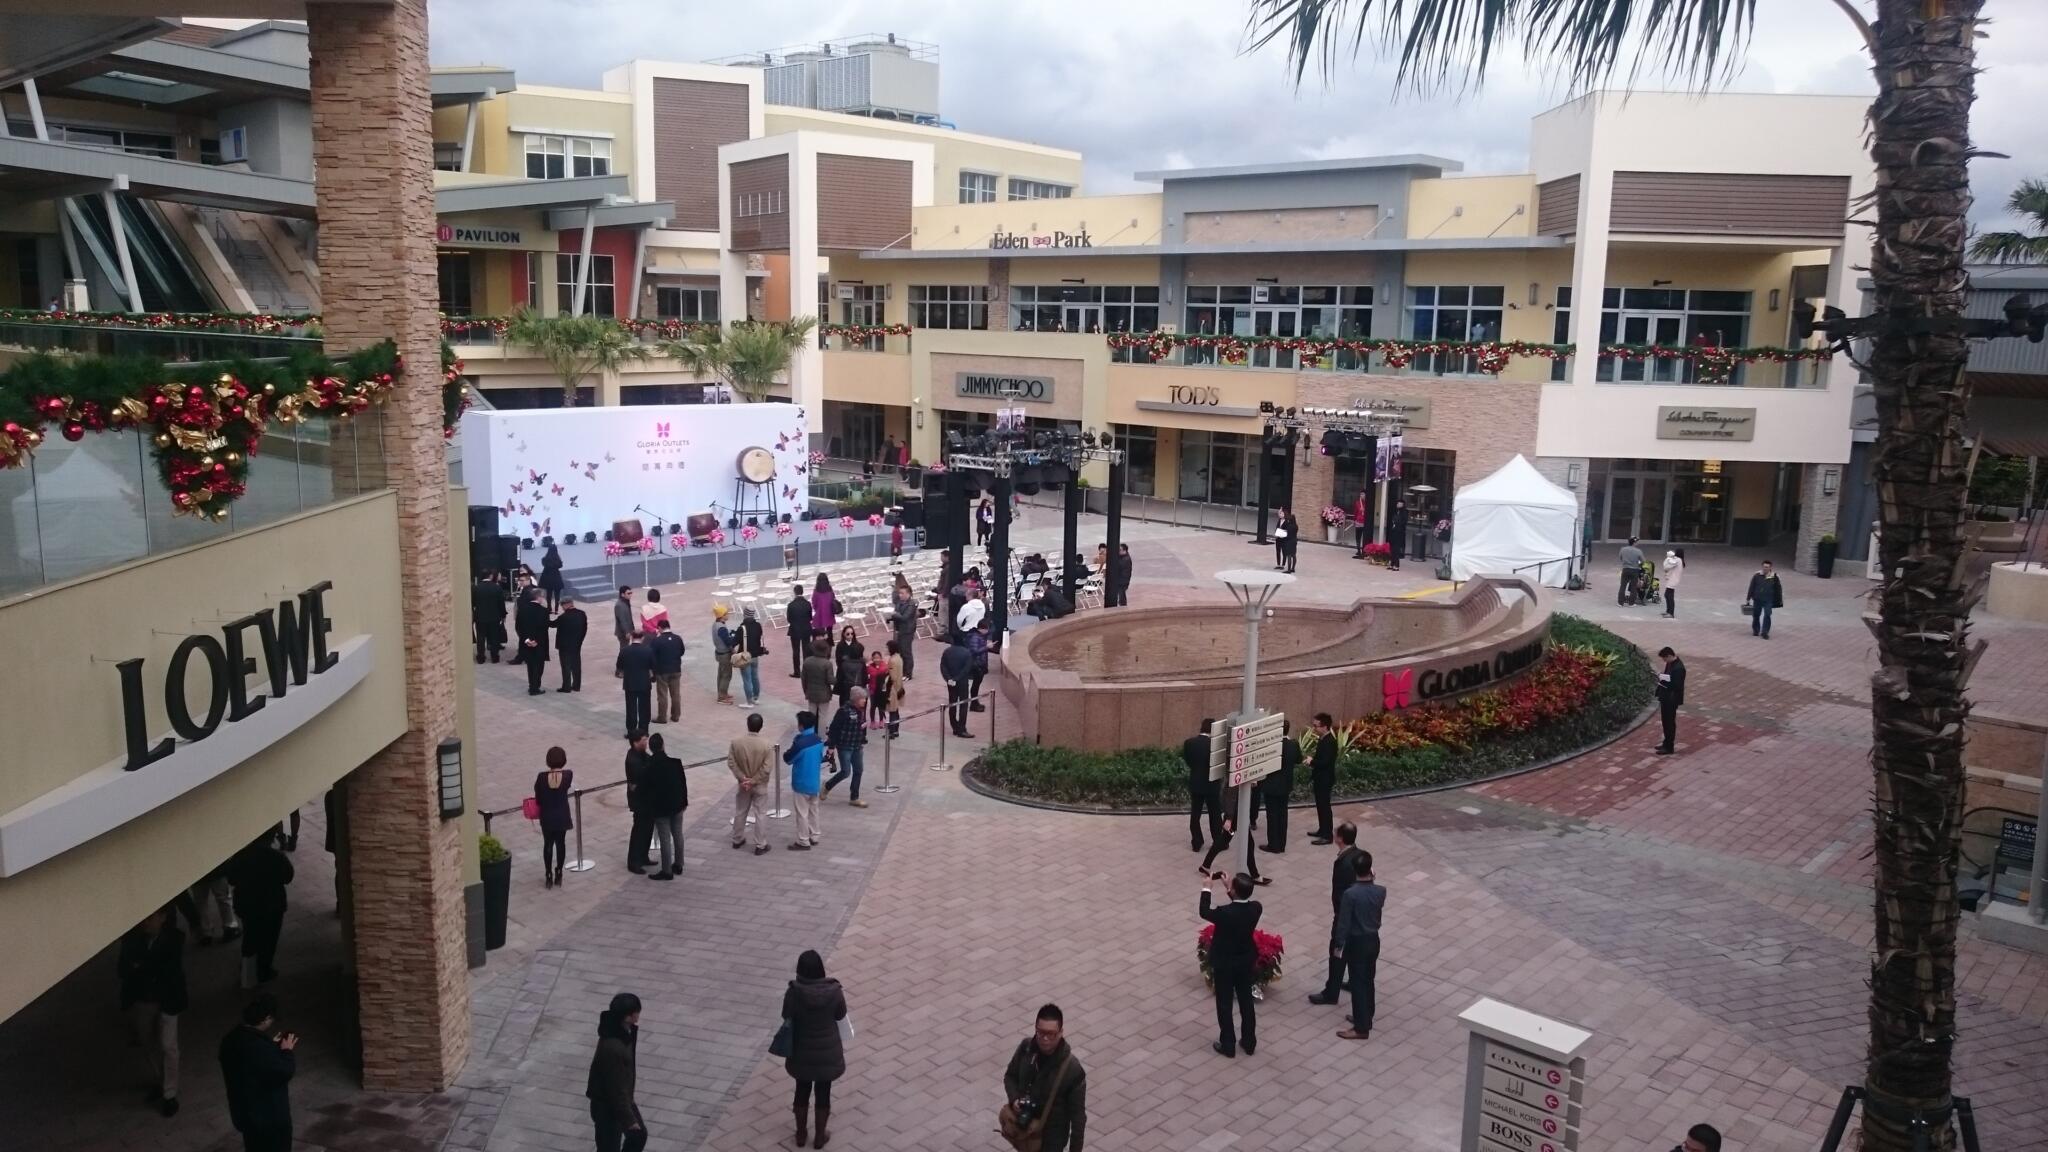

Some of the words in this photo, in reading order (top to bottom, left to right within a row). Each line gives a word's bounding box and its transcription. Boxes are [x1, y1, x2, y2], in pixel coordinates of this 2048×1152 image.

[455, 229, 520, 243] PAVILION
[993, 232, 1029, 249] Eden
[1051, 230, 1092, 248] Park
[1168, 385, 1220, 406] TOD'S
[115, 580, 339, 772] LOEWE
[1418, 661, 1490, 699] GLORIA
[1491, 1053, 1541, 1076] COACH
[1484, 1098, 1517, 1116] MICHAEL
[1519, 1111, 1543, 1126] KORS
[1491, 1121, 1532, 1147] BOSS
